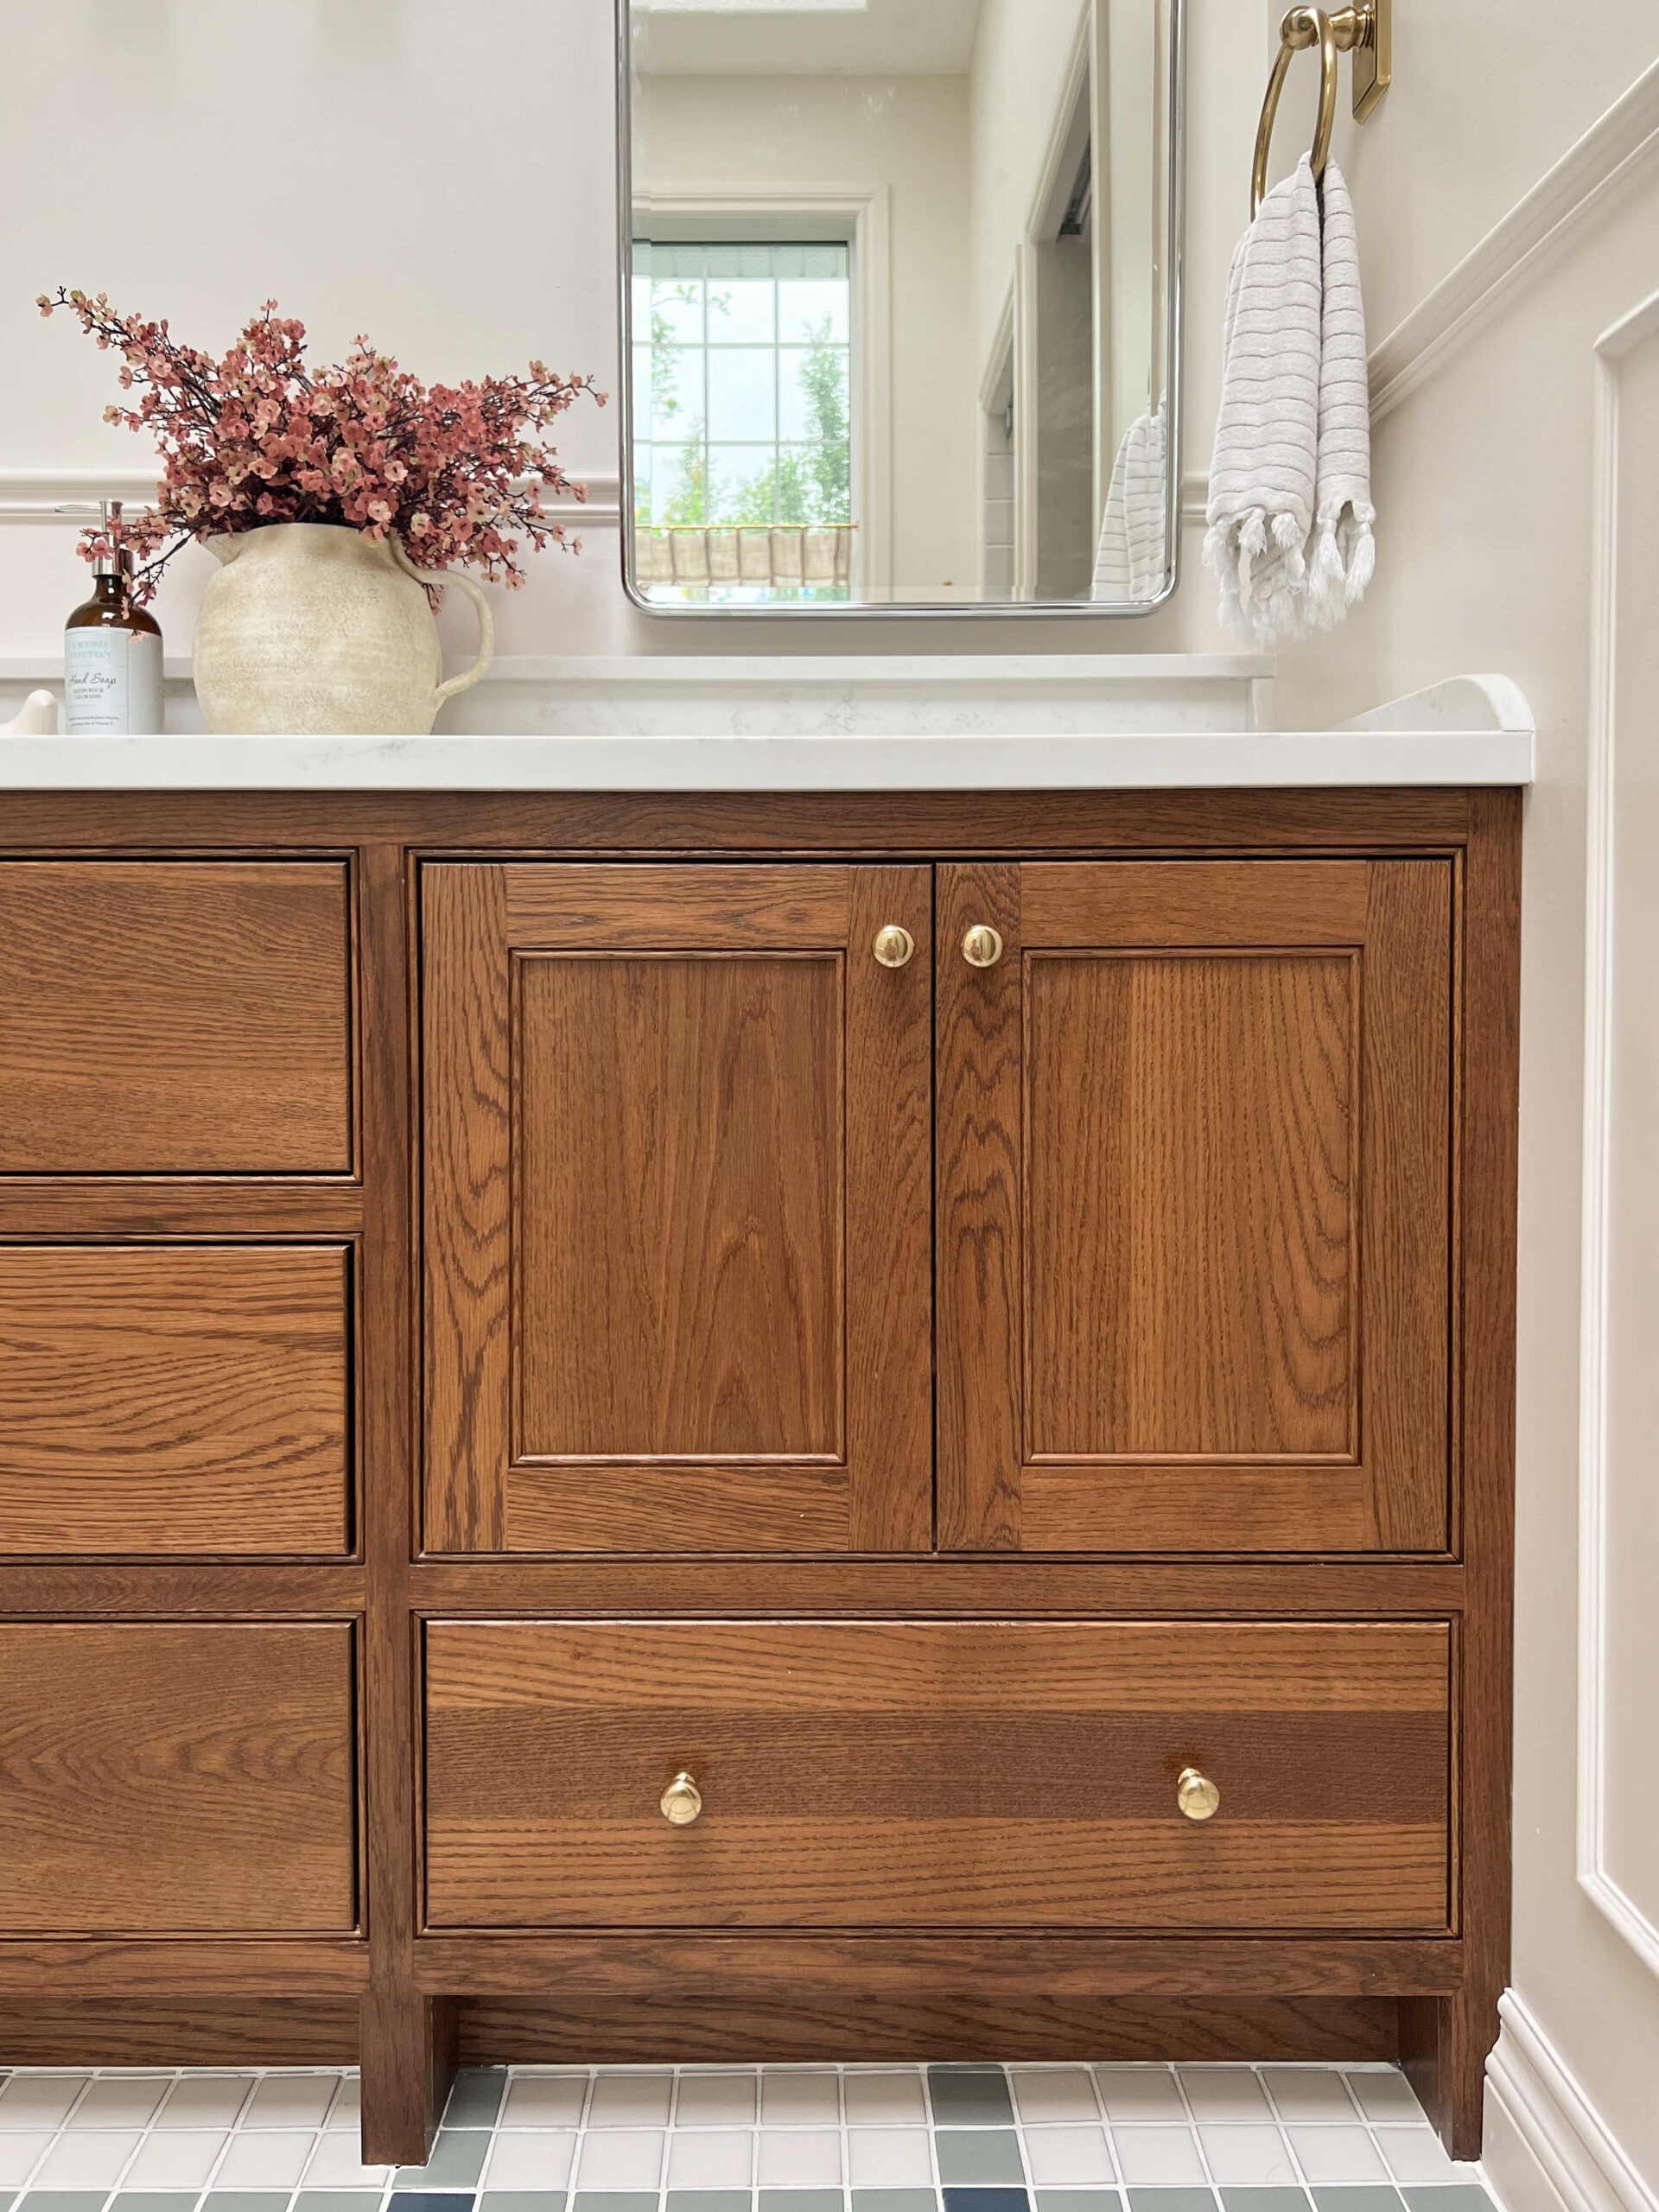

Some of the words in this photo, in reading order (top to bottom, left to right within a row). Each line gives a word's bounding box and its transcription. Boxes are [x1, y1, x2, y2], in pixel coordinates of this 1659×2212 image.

[69, 651, 111, 659] COTTON
[67, 672, 89, 688] Hand
[91, 672, 118, 689] Soap
